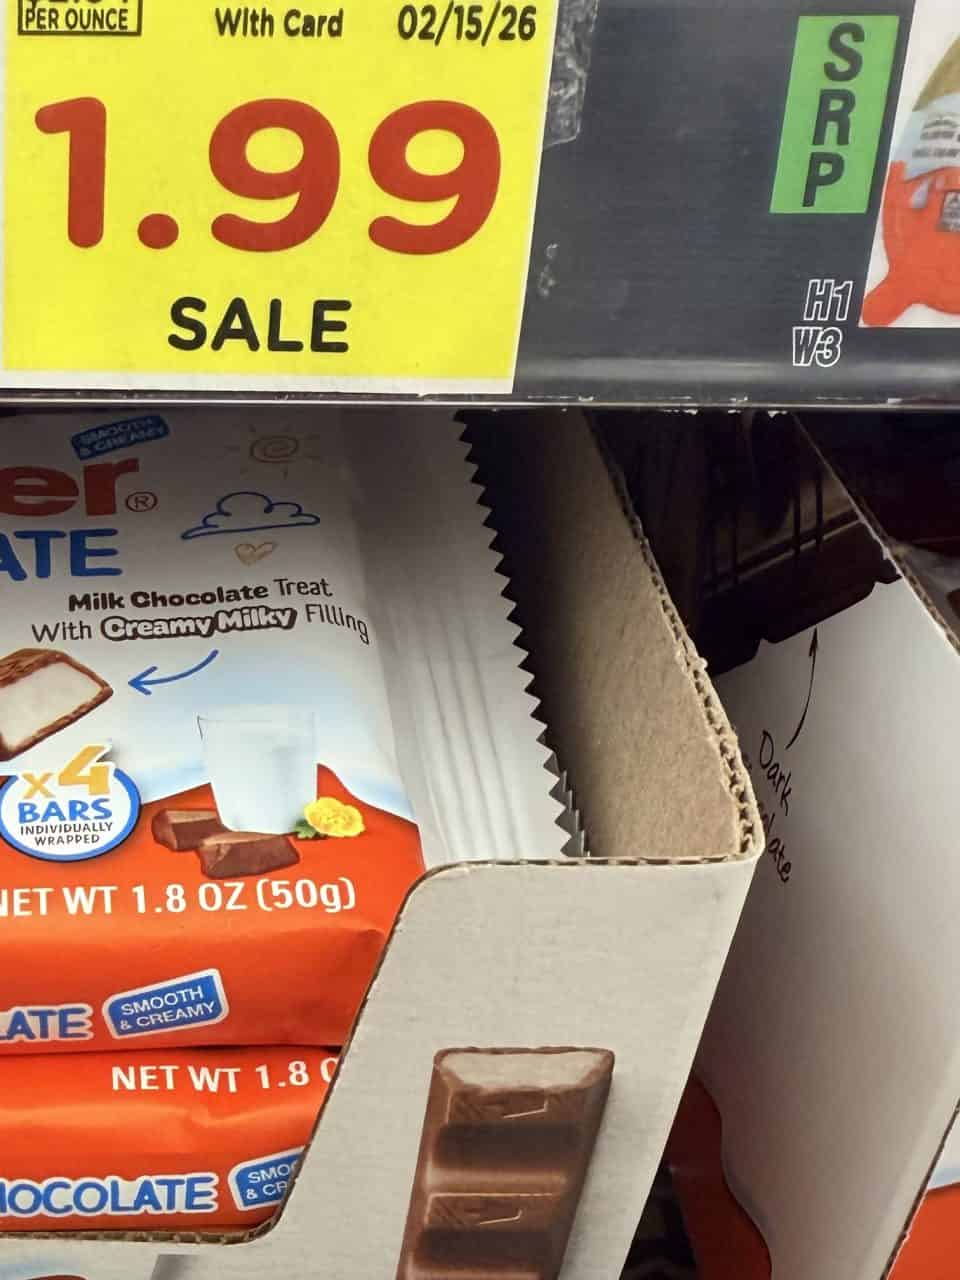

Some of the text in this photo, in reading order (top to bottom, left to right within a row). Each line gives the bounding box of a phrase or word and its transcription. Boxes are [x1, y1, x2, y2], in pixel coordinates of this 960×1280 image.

[25, 7, 129, 30] PER OUNCE
[284, 9, 343, 37] Card
[397, 5, 536, 46] 02/15/26
[34, 97, 501, 256] 1.99
[803, 279, 853, 321] H1
[167, 296, 352, 353] SALE
[792, 326, 842, 367] W3
[69, 578, 332, 612] Milk Chocolate Treat
[32, 603, 370, 646] With Creamy Milky Filling
[21, 745, 111, 798] x4
[760, 730, 791, 816] Dark
[18, 799, 112, 824] BARS
[20, 822, 113, 837] INDIVIDUALLY
[34, 832, 100, 847] WRAPPED
[64, 886, 117, 915] WT
[132, 884, 185, 913] 1.8
[199, 882, 246, 911] OZ
[257, 877, 356, 913] (50g)
[120, 984, 204, 1016] SMOOTH
[136, 1000, 215, 1029] CREAMY
[112, 1066, 179, 1090] NET
[188, 1066, 240, 1092] WT
[256, 1060, 309, 1088] 1.8
